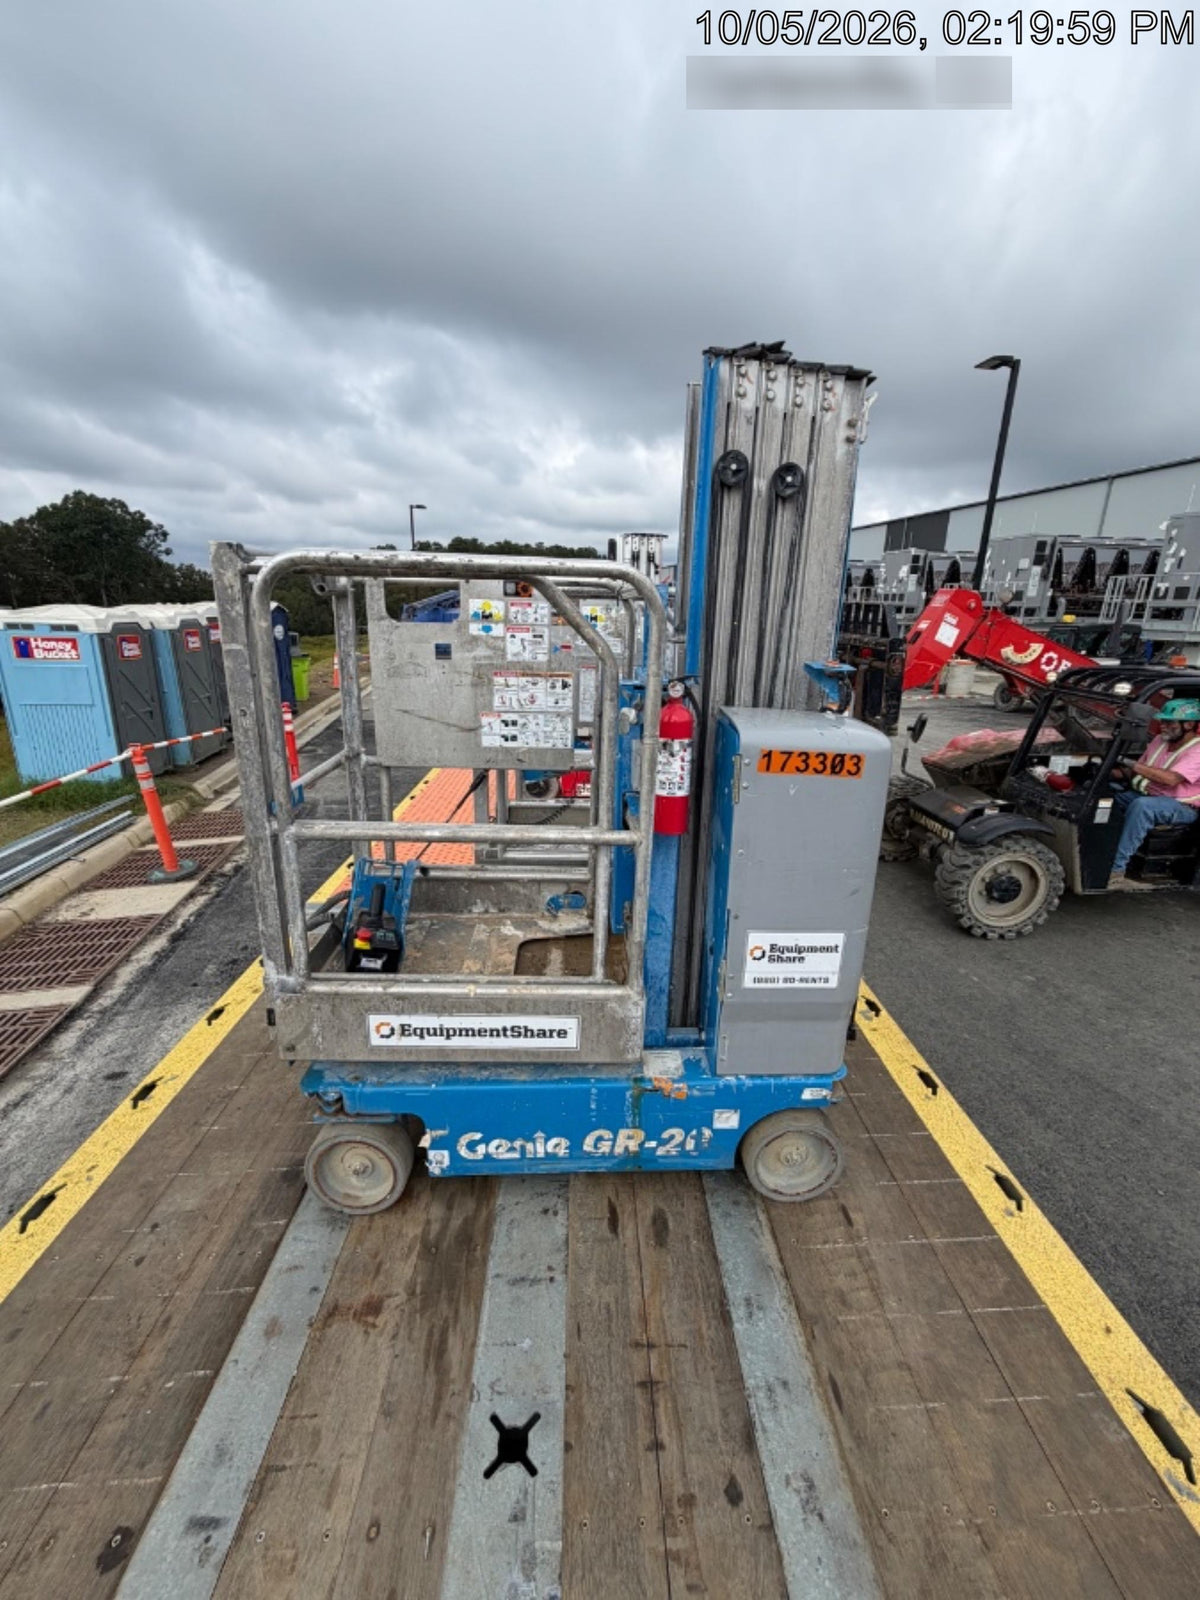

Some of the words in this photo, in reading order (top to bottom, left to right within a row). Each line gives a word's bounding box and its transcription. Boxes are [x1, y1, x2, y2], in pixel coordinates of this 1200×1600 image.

[30, 637, 72, 651] Honey
[761, 749, 862, 776] 173303
[769, 944, 839, 955] Equipment
[768, 954, 806, 964] Share
[400, 1023, 568, 1040] EquipmentShare
[456, 1129, 570, 1160] Genie
